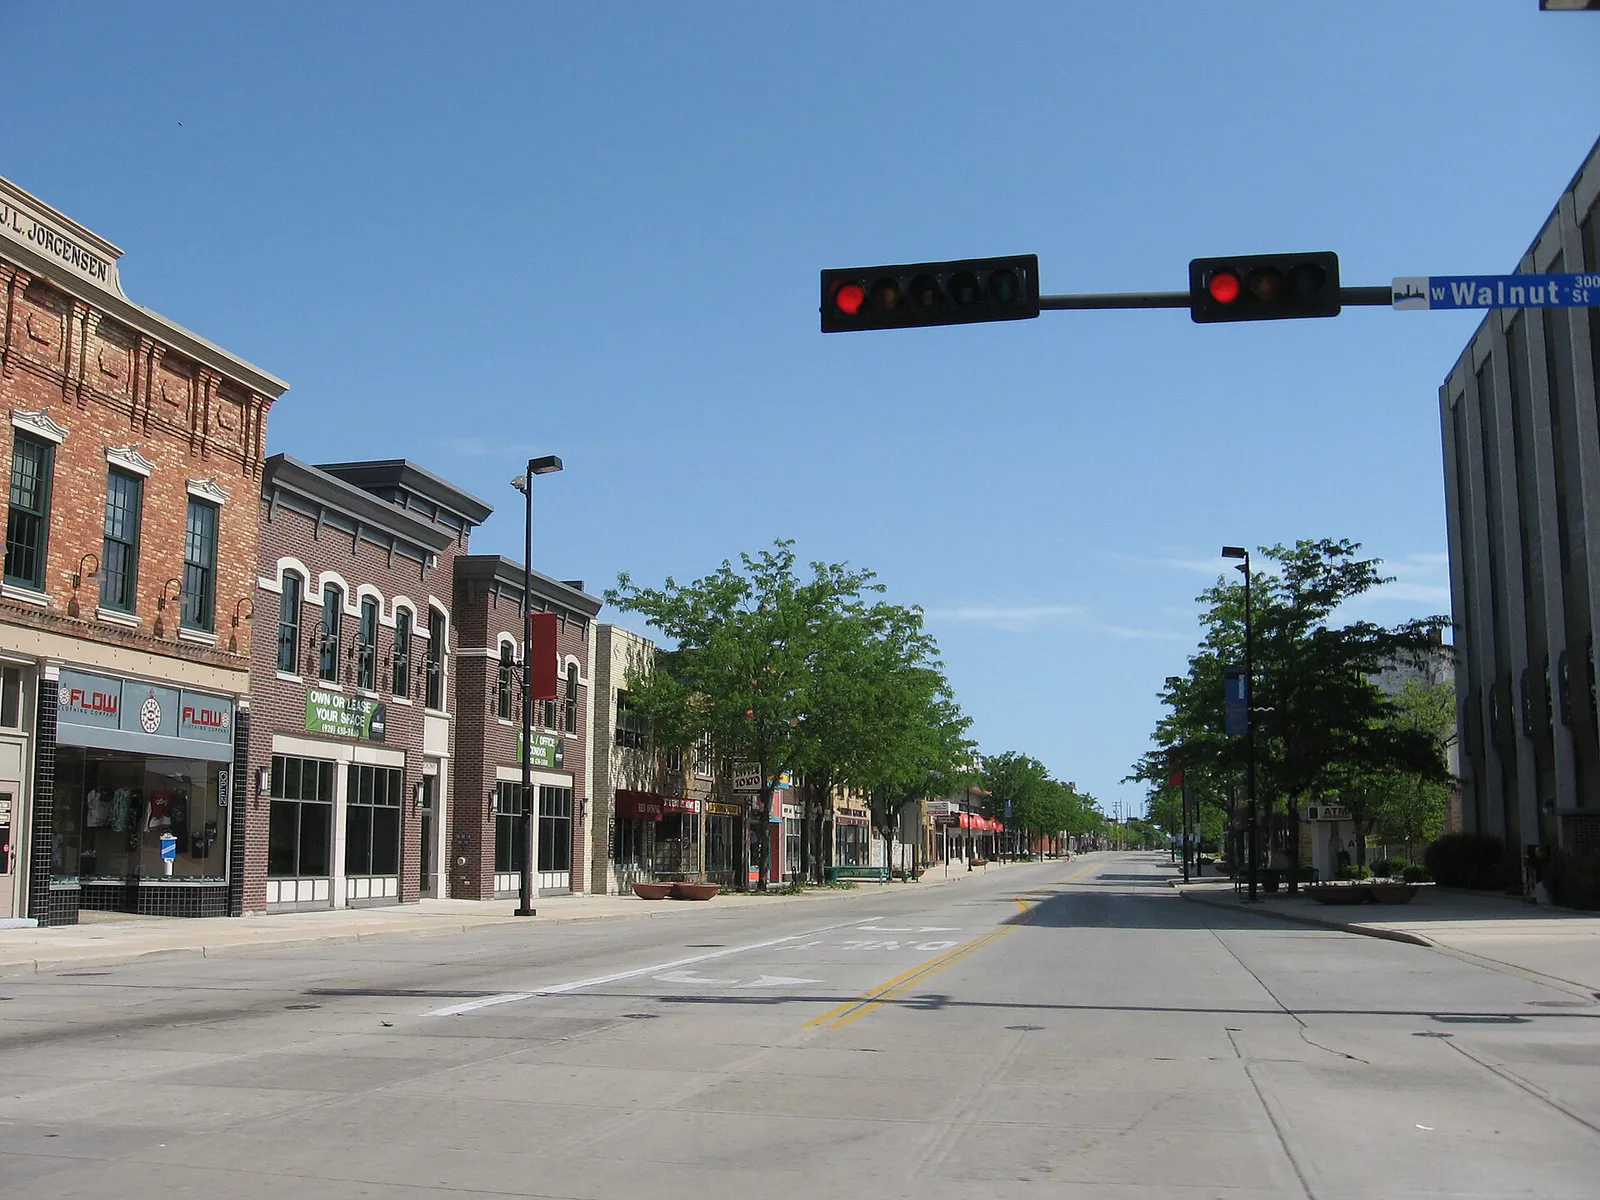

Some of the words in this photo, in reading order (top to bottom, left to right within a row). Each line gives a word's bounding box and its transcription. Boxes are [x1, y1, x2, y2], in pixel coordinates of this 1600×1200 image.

[0, 206, 25, 236] J.L.
[28, 223, 107, 282] JORGENSEN
[1575, 276, 1600, 288] 300
[1431, 287, 1446, 301] W
[1451, 281, 1559, 306] Walnut
[1572, 288, 1589, 303] St
[70, 689, 118, 713] FLOW
[310, 690, 331, 706] OWN
[332, 695, 345, 709] OR
[347, 698, 372, 714] LEASE
[183, 706, 222, 727] FLOW
[316, 707, 338, 722] YOUR
[340, 711, 366, 727] SPACE
[735, 775, 760, 788] TOKYO
[1323, 807, 1350, 817] ATM
